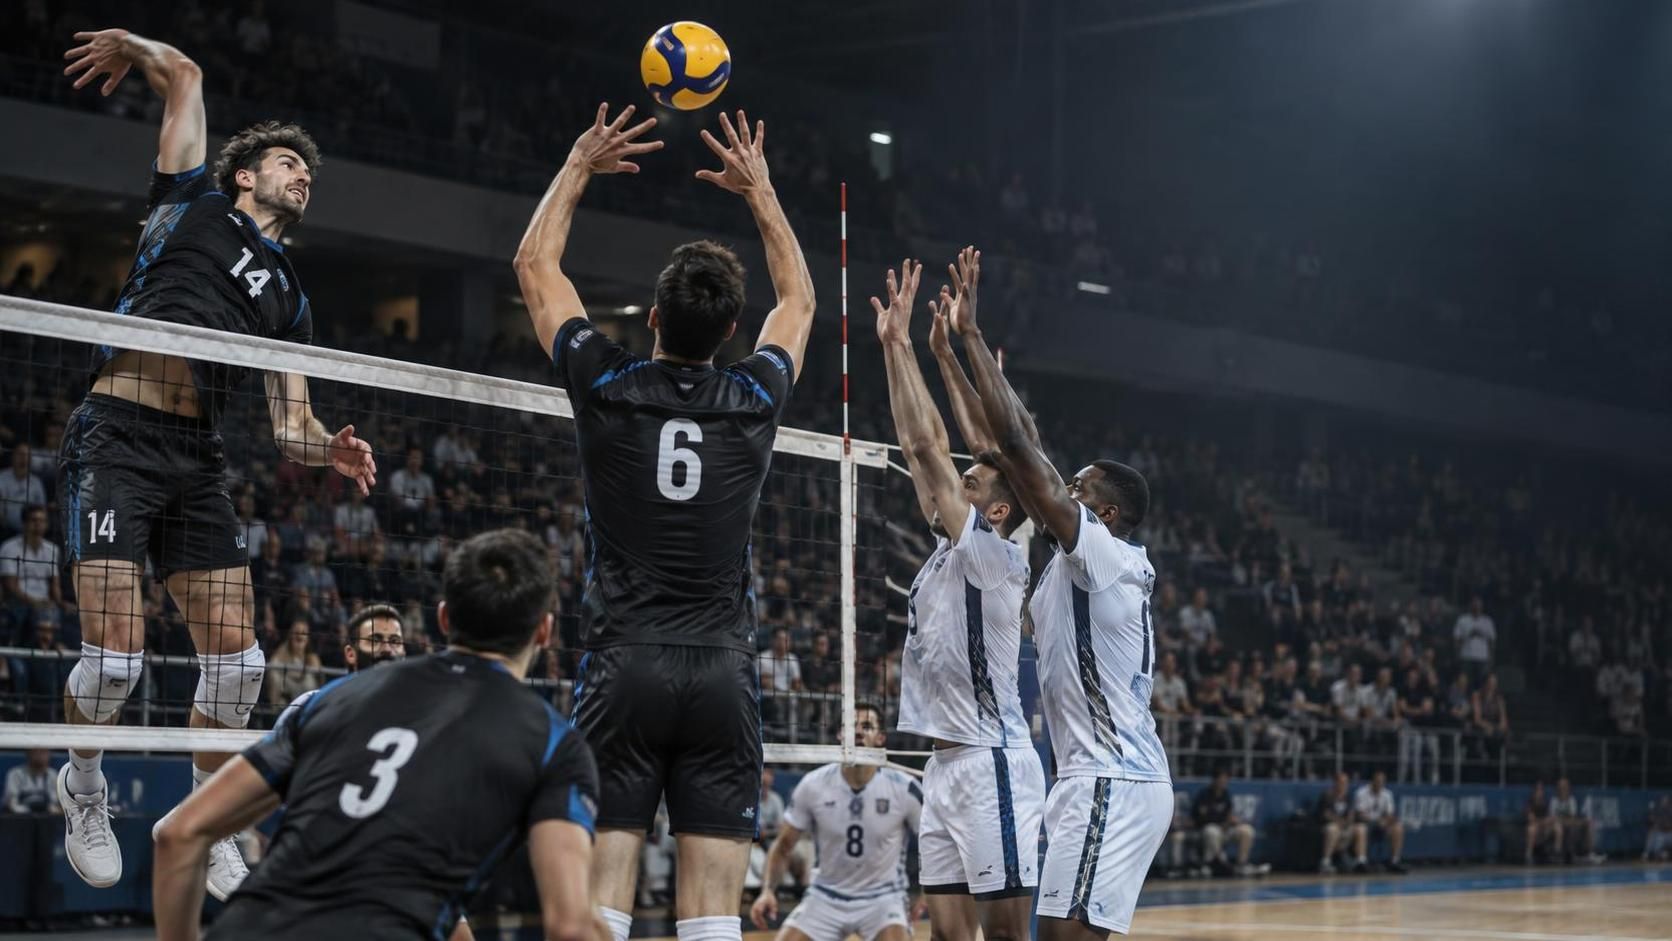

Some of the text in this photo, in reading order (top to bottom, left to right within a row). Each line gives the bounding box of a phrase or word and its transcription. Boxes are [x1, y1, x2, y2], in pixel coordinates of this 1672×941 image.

[229, 247, 271, 298] 14
[657, 417, 703, 501] 6
[87, 510, 116, 544] 14
[339, 727, 419, 819] 3
[846, 824, 863, 858] 8
